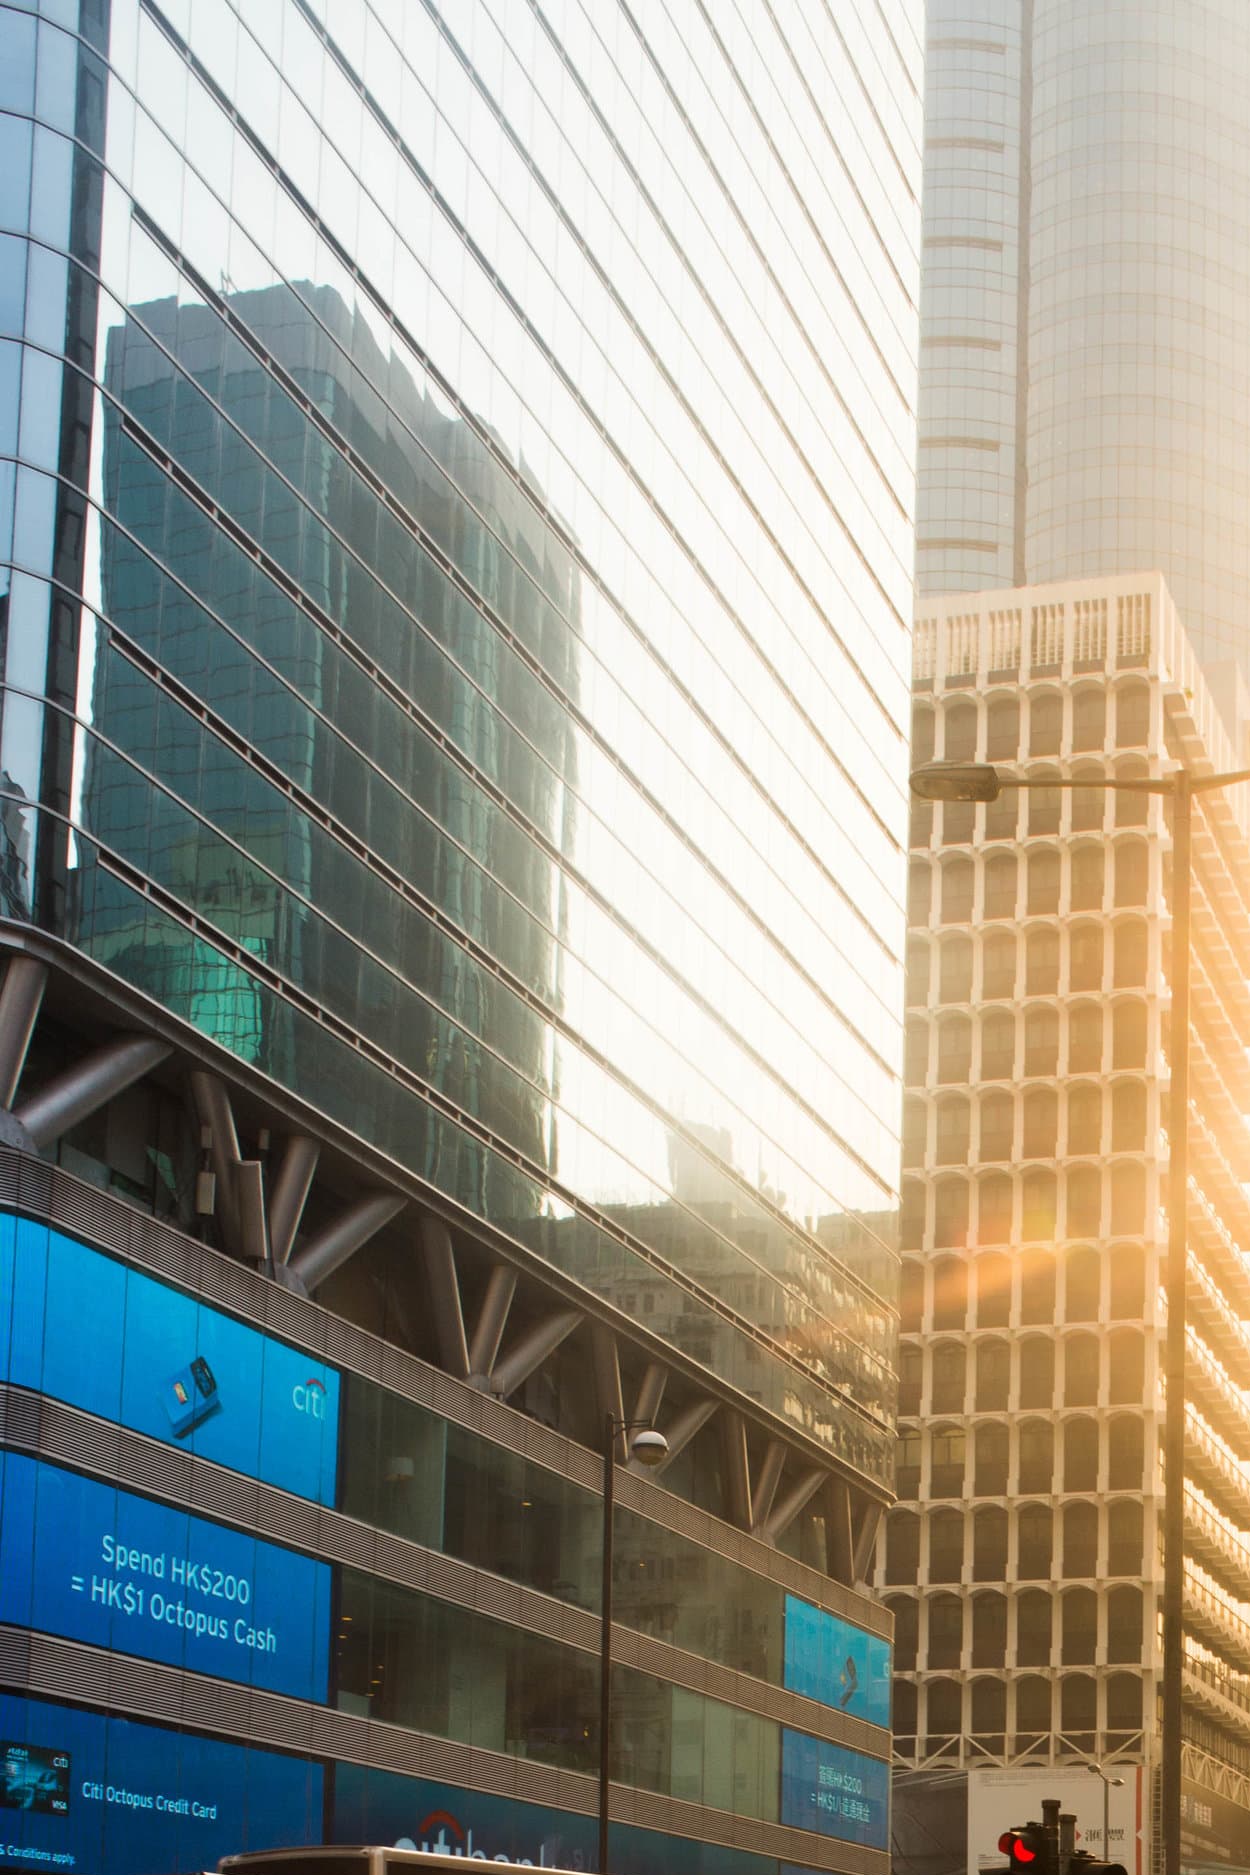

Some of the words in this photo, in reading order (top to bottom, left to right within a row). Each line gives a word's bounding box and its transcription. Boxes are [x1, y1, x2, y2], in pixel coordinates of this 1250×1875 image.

[292, 1384, 328, 1420] citi
[102, 1535, 165, 1579] Spend
[171, 1556, 250, 1604] HK$200
[91, 1575, 144, 1616] HK$1
[150, 1593, 228, 1640] Octopus
[234, 1618, 277, 1653] Cash
[82, 1782, 104, 1800] Citi
[106, 1786, 153, 1809] Octopus
[156, 1795, 189, 1815] Credit
[192, 1802, 217, 1819] Card
